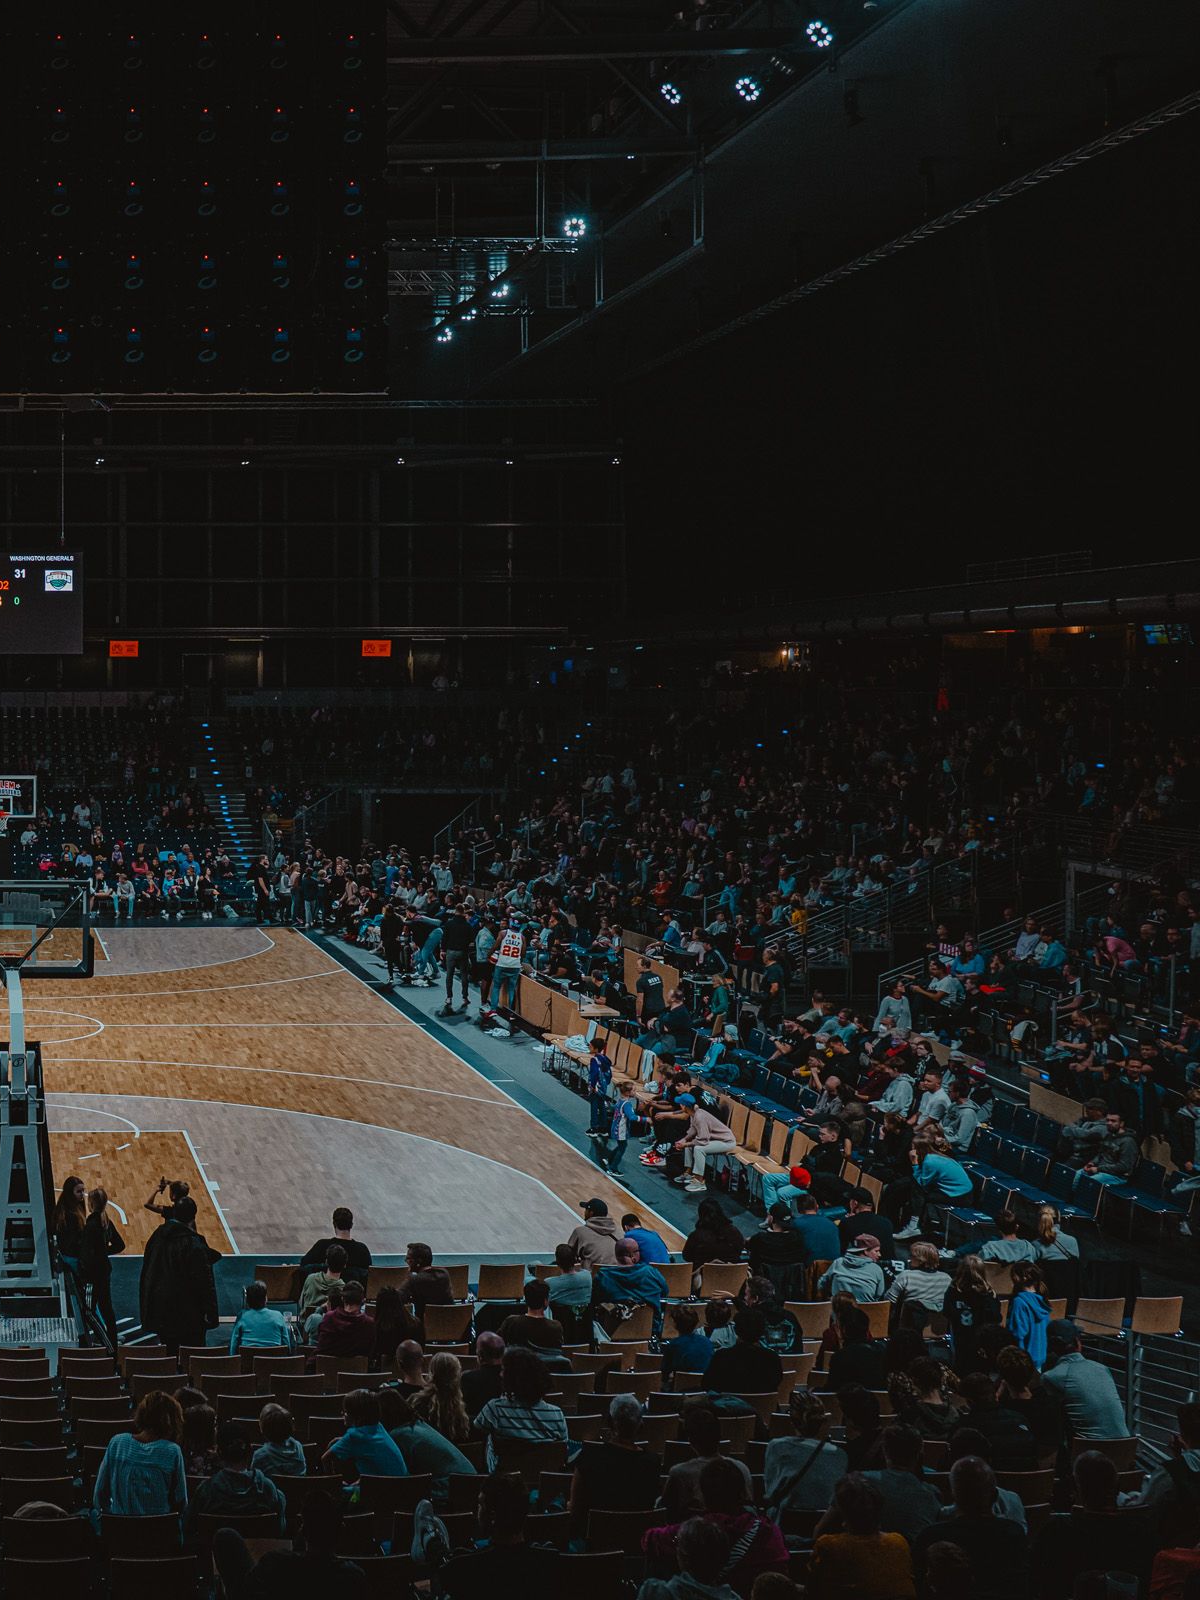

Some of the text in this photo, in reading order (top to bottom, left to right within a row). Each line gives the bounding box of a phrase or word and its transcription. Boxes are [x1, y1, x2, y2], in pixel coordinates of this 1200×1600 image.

[14, 568, 26, 579] 31
[13, 596, 20, 606] 0
[502, 945, 520, 958] 22
